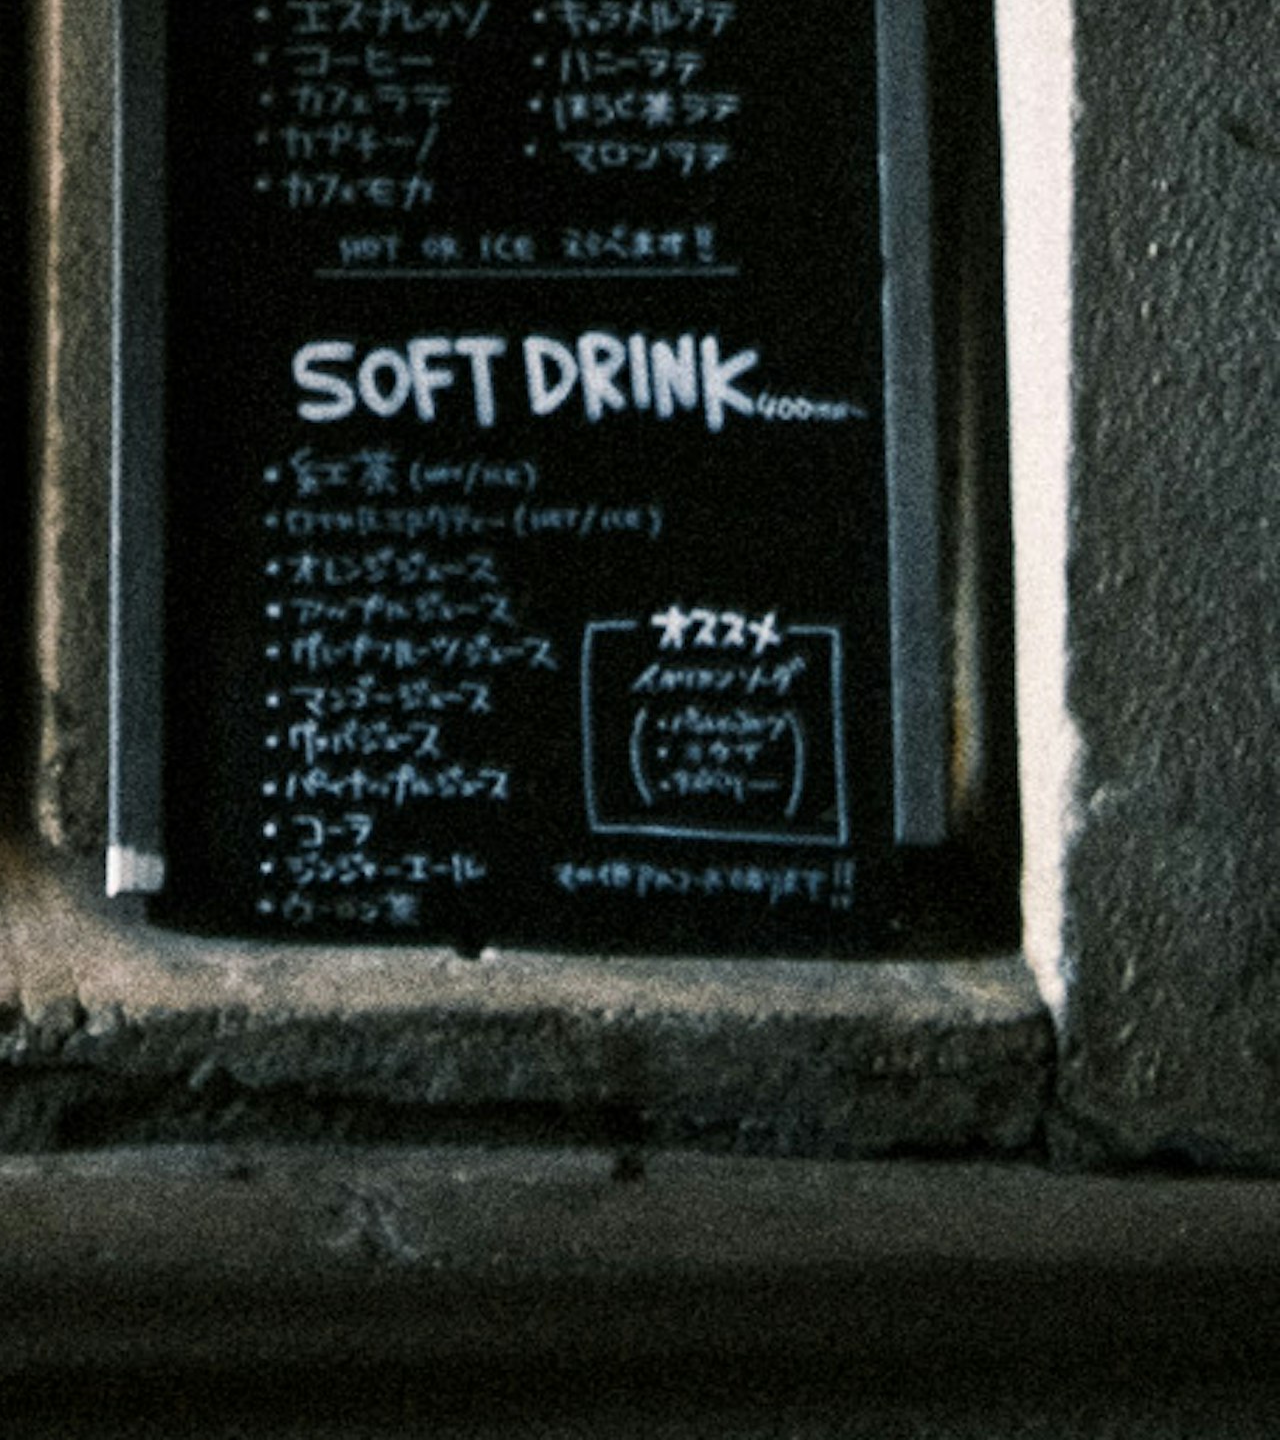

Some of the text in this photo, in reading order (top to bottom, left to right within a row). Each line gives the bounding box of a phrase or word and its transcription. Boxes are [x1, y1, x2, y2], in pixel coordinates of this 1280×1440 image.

[283, 42, 435, 78] コーヒー
[291, 336, 506, 431] SOFT
[522, 330, 760, 435] DRINK
[648, 604, 783, 656] オススメ
[291, 810, 375, 849] コーラ
